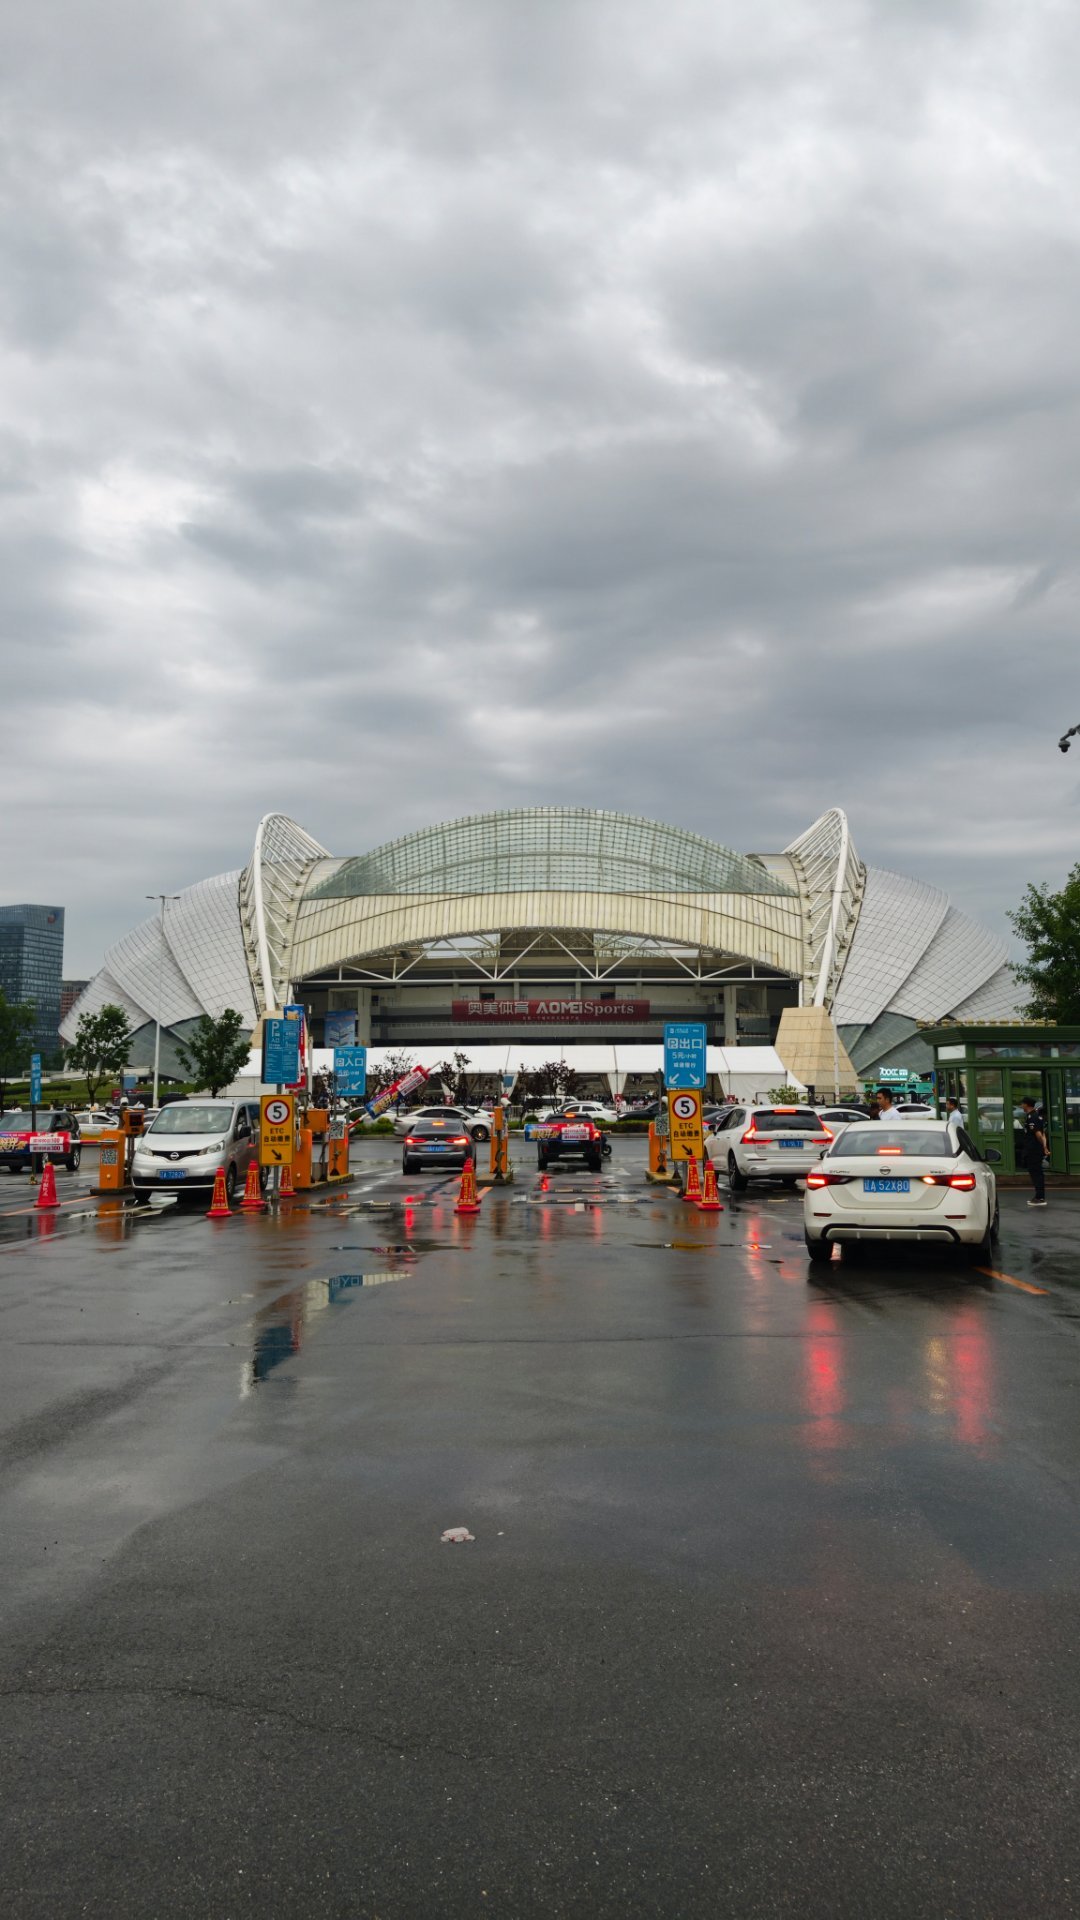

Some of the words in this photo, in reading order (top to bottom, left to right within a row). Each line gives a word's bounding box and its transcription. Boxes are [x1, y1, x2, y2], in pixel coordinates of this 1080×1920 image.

[468, 1001, 529, 1015] 奥美体育
[273, 1105, 283, 1120] 5
[680, 1101, 690, 1115] 5
[270, 1127, 285, 1135] ETC
